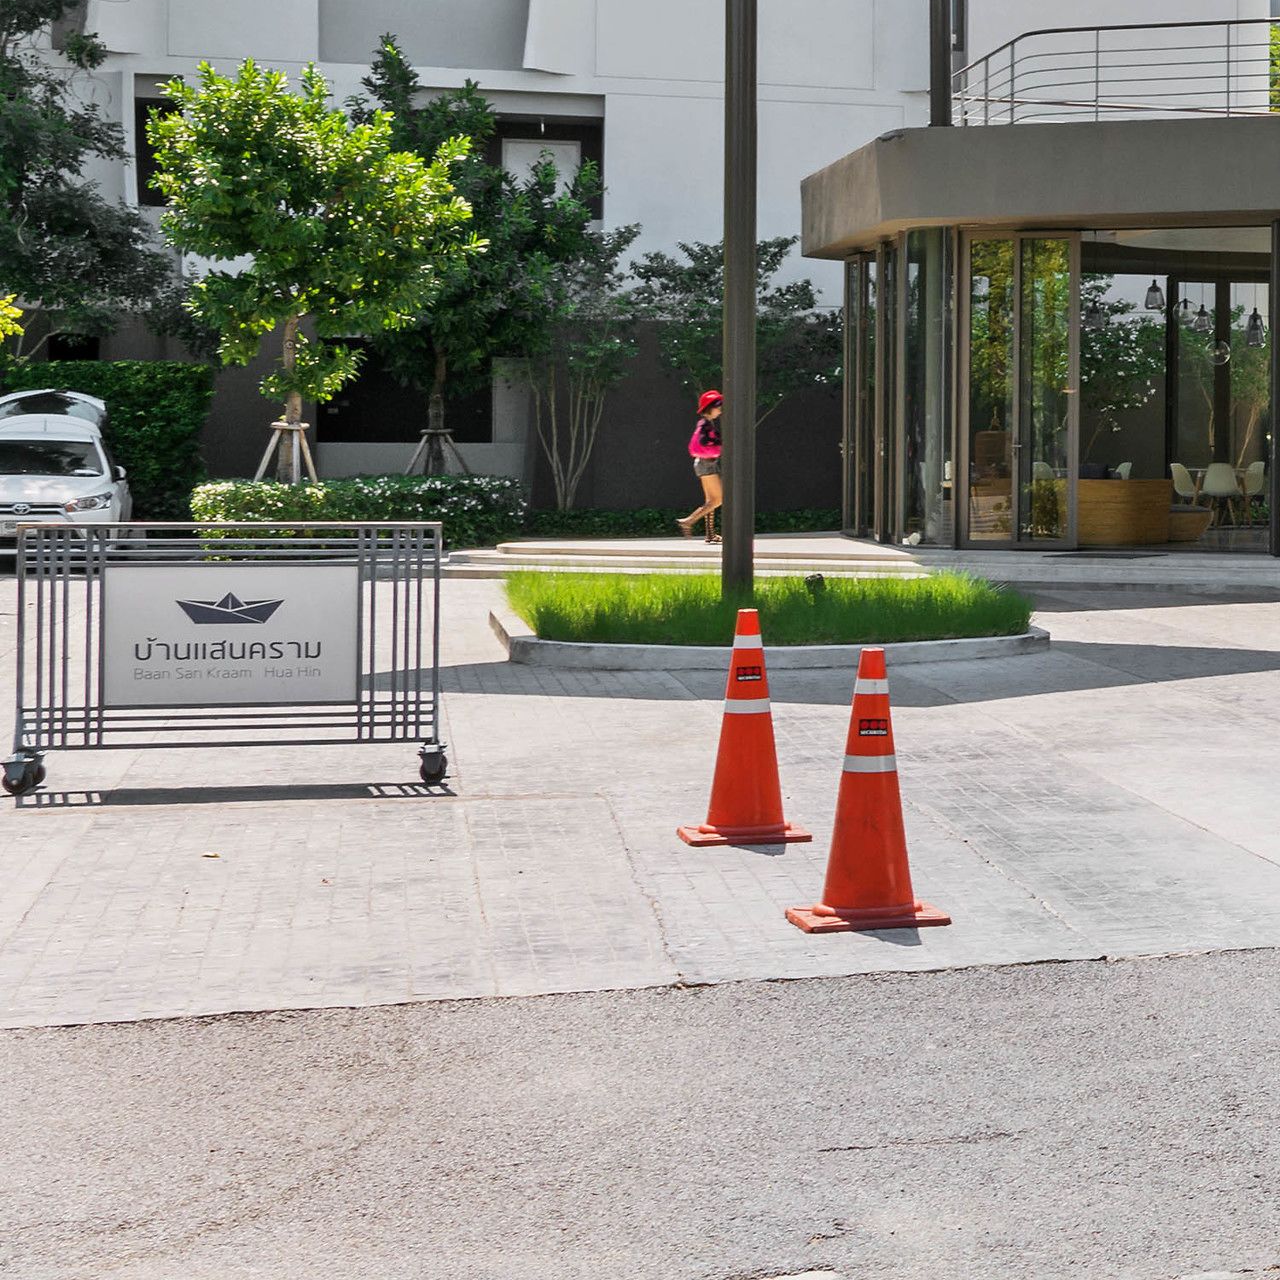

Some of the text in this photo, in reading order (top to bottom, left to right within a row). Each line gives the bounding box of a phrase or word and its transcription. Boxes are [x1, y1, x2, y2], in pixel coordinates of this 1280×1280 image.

[135, 637, 322, 660] บ้านแสนคราม
[134, 665, 322, 680] Baan San Kraam Hua Hin
